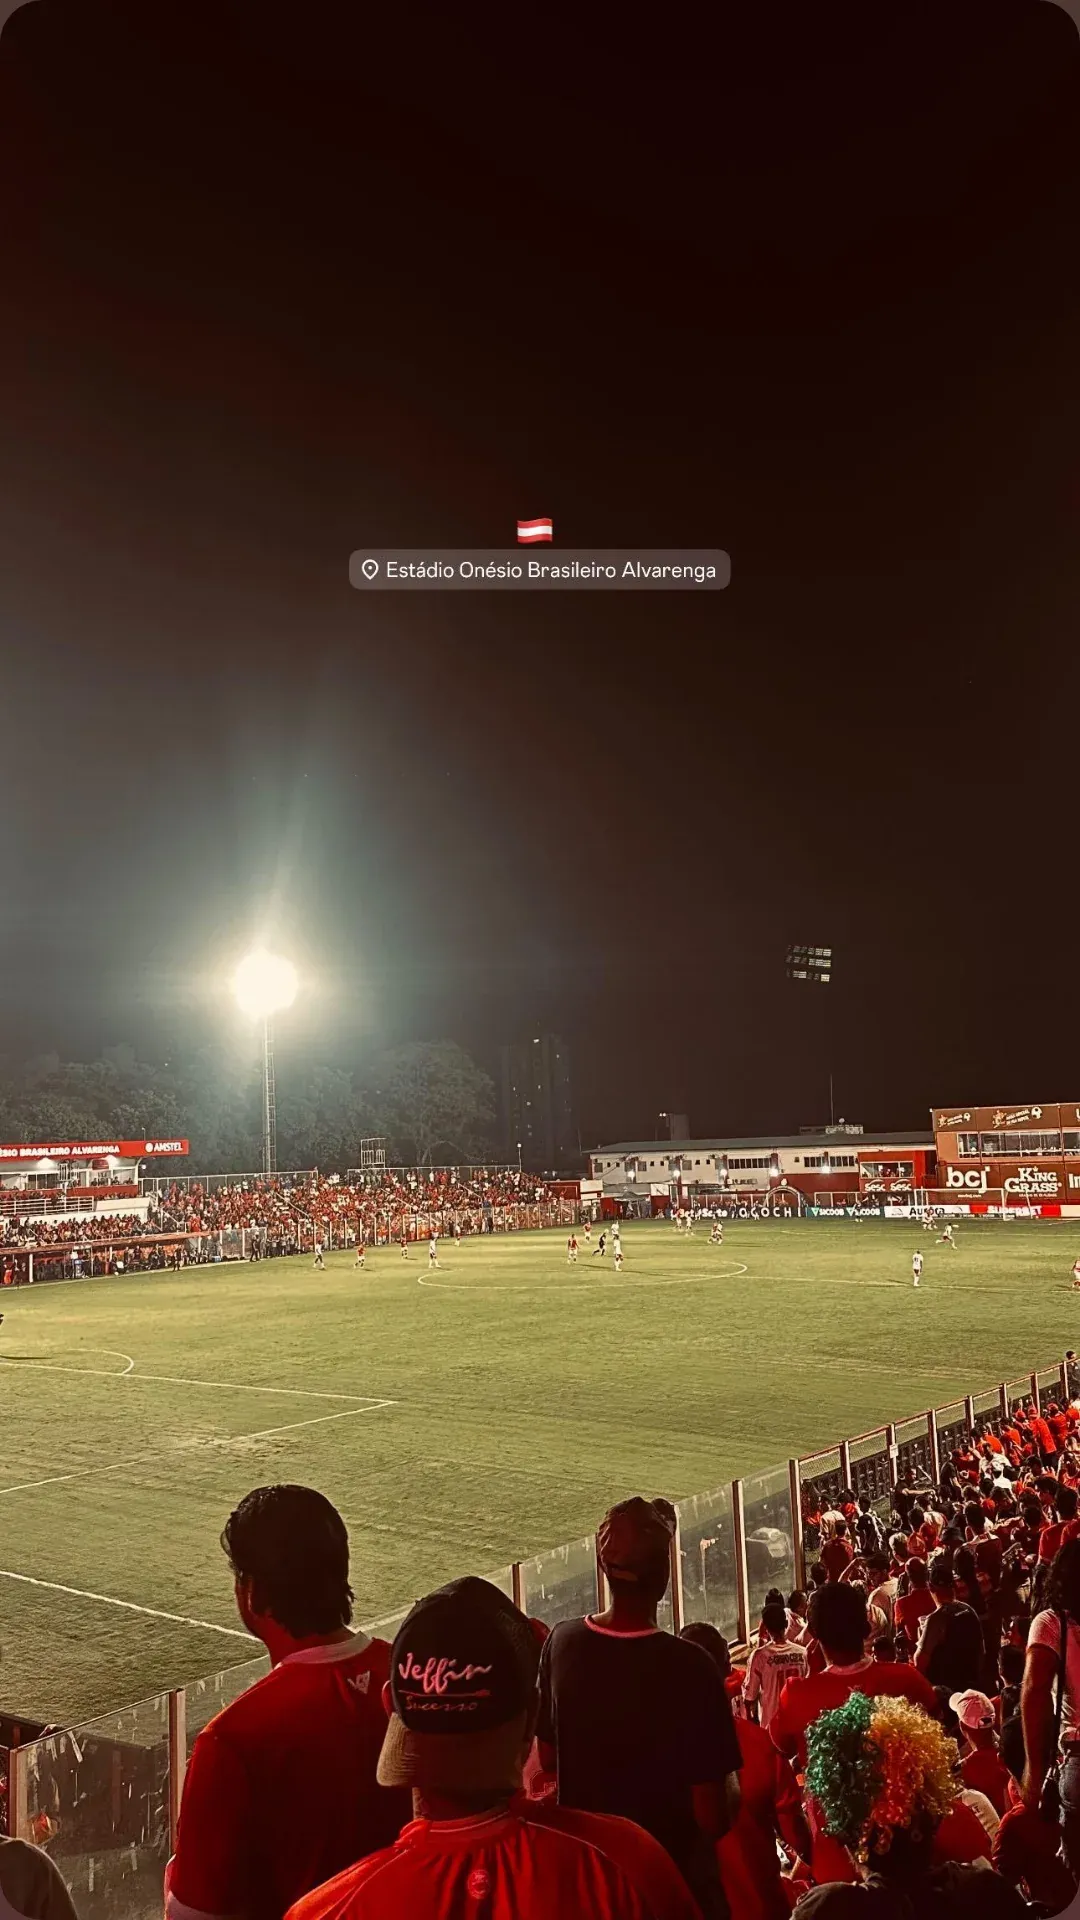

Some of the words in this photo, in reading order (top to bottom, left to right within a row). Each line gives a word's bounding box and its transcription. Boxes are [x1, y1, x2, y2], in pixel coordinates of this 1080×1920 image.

[20, 1147, 70, 1157] BRASILEIRO
[71, 1145, 120, 1155] ALVARENGA
[154, 1142, 183, 1152] AMSTEL
[946, 1166, 990, 1193] bcj
[1018, 1167, 1057, 1182] KING
[1004, 1177, 1058, 1192] GRASS
[819, 1208, 844, 1216] SICOOB
